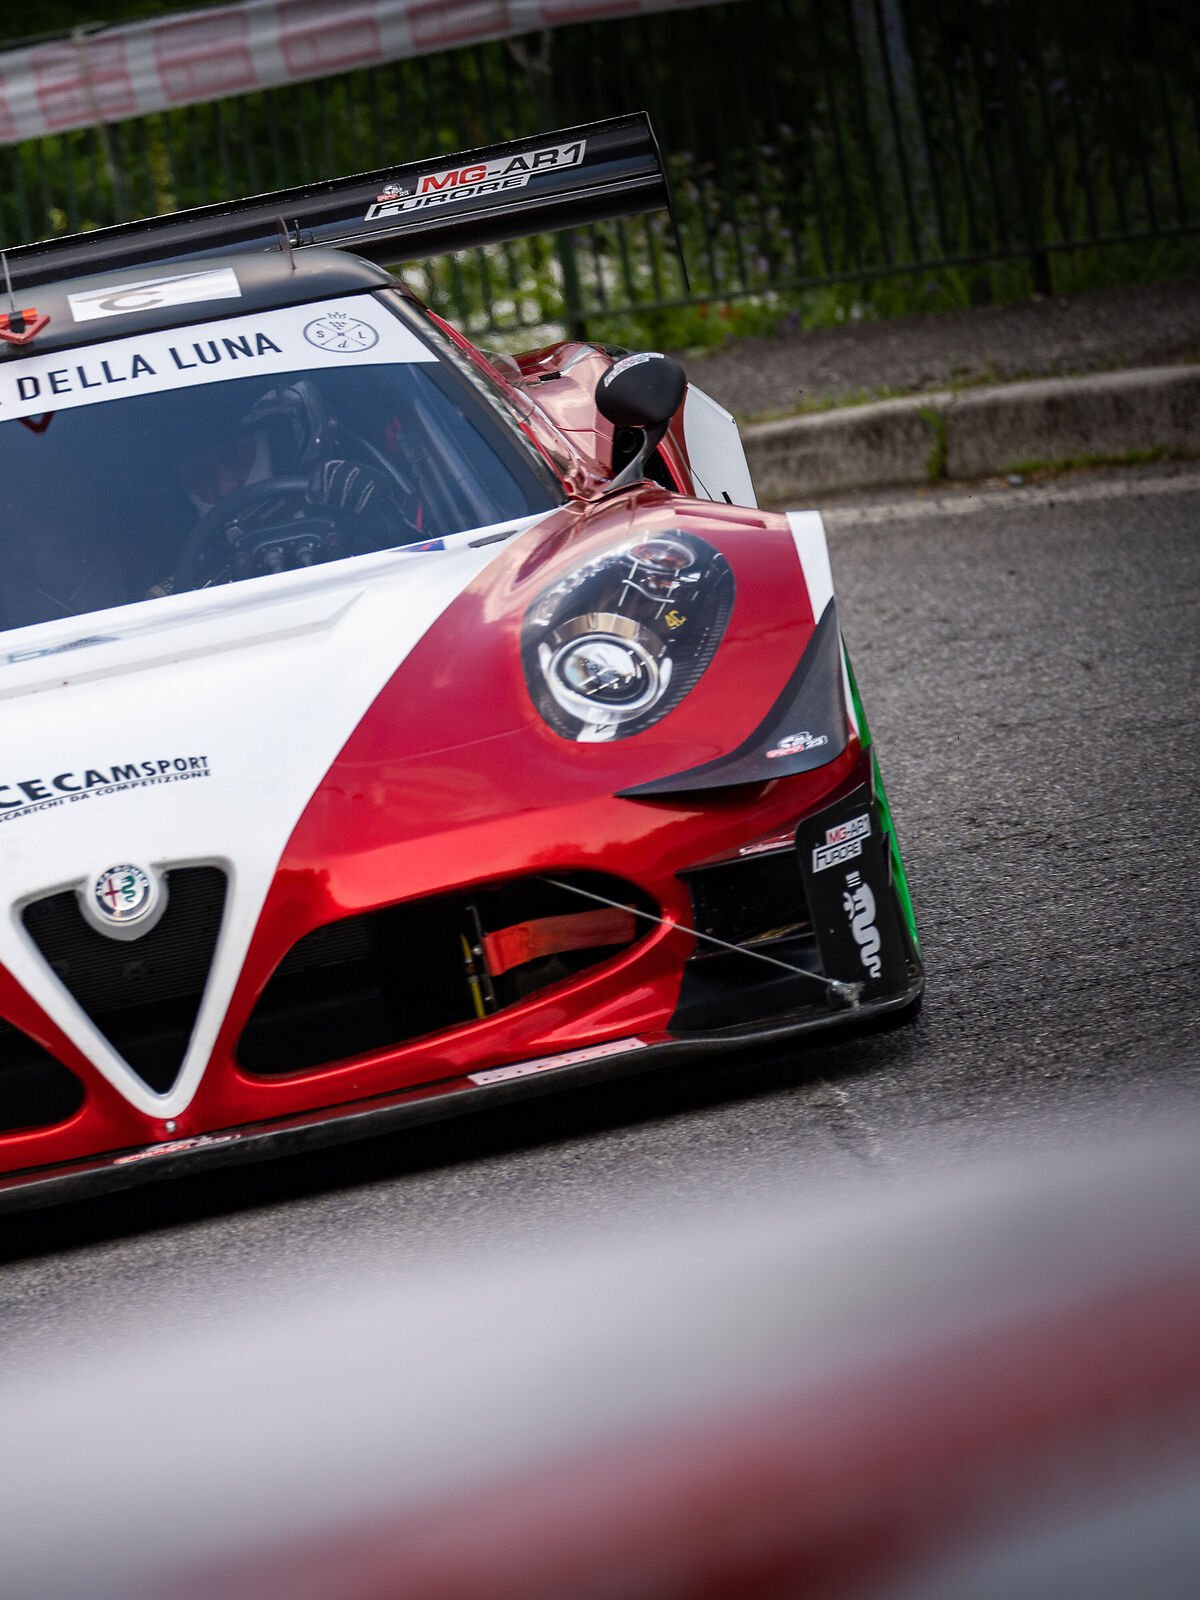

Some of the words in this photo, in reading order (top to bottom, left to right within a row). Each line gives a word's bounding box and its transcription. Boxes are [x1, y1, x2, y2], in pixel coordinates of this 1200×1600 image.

[422, 143, 582, 193] MG-AR1
[371, 175, 525, 217] FURORE
[16, 353, 157, 402] DELLA
[168, 332, 282, 370] LUNA
[70, 793, 90, 802] DA
[95, 769, 211, 796] COMPETIZIONE
